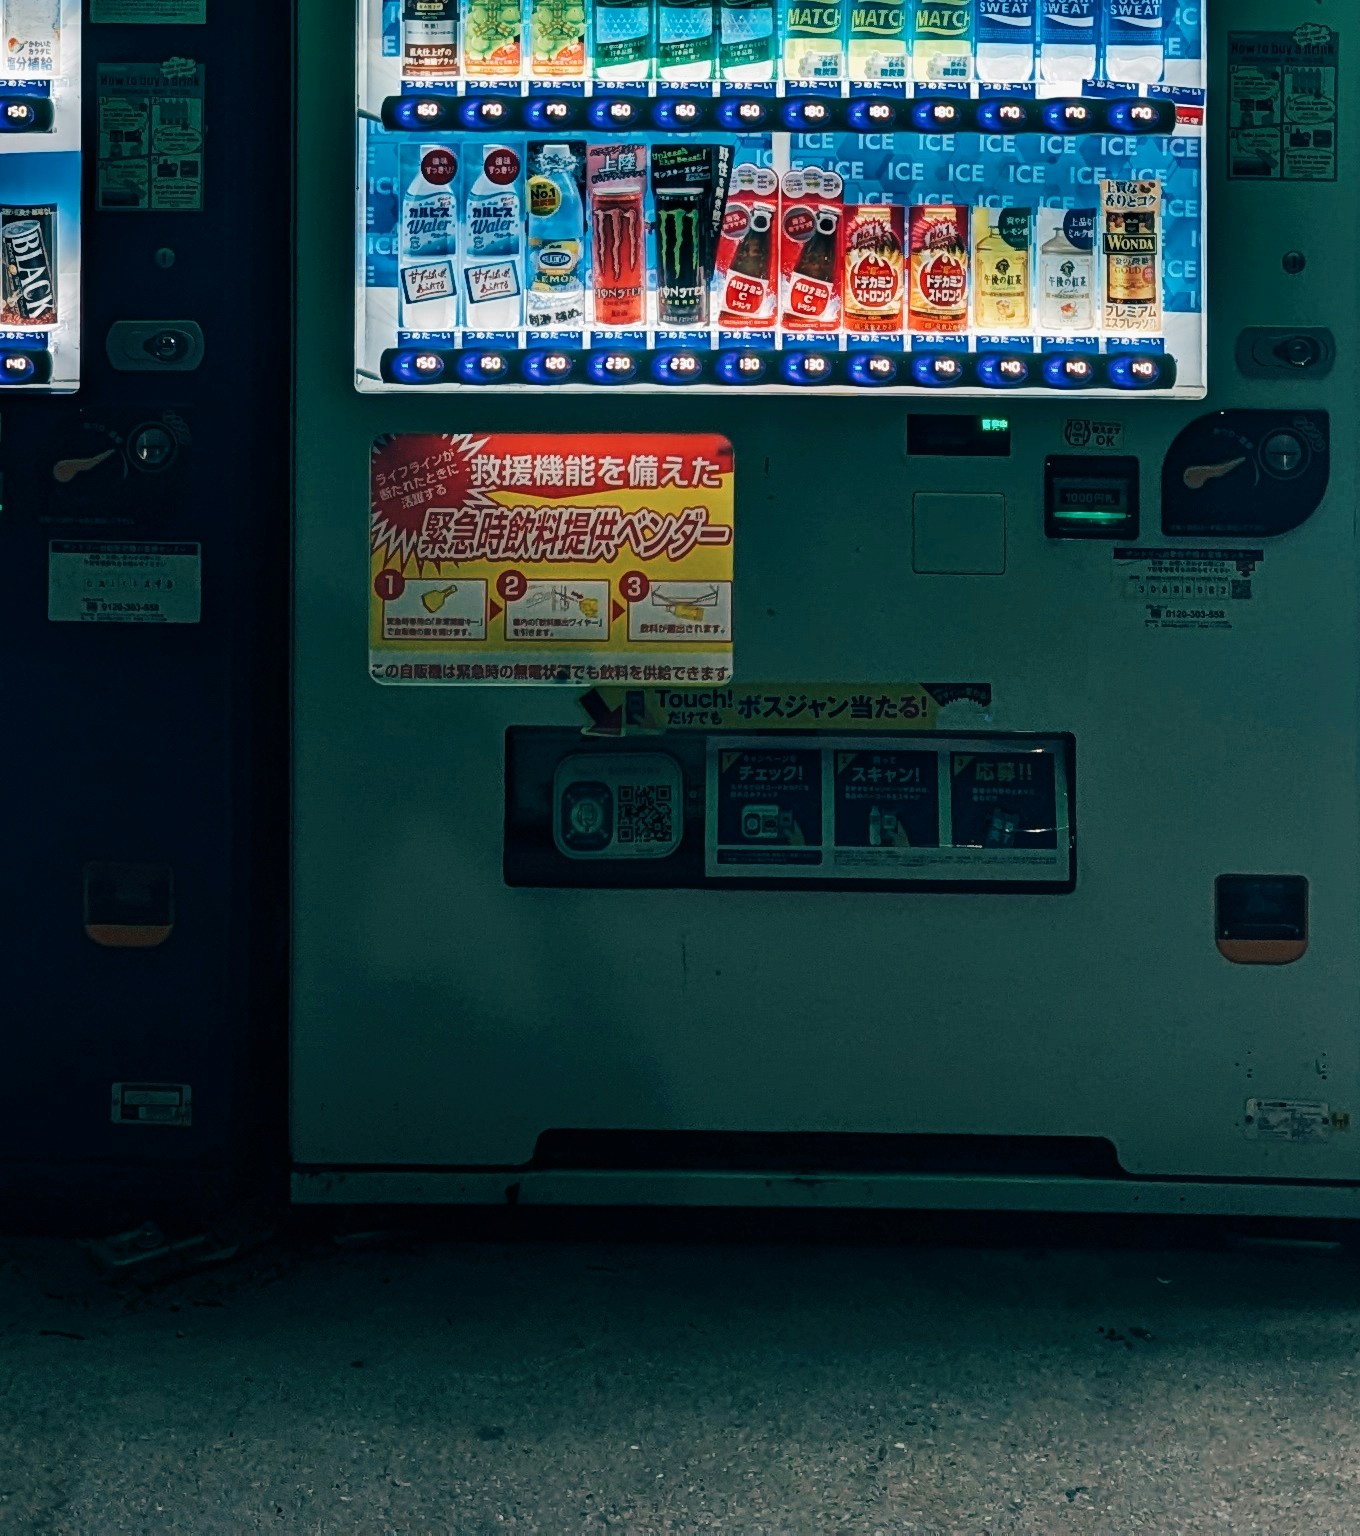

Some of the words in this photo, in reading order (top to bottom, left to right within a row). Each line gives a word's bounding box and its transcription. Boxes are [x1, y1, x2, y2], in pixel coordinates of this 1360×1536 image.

[979, 3, 1027, 14] SWEAT
[1043, 4, 1090, 15] SWEAT
[1110, 4, 1160, 16] SWEAT
[799, 133, 834, 149] ICE
[858, 133, 894, 152] ICE
[919, 133, 954, 152] ICE
[979, 134, 1015, 153] ICE
[597, 154, 636, 173] 上陸
[1106, 181, 1138, 195] 上質な
[1104, 194, 1156, 207] 香りとコク
[409, 207, 452, 218] カルピス
[472, 207, 515, 218] カルピス
[407, 218, 452, 235] Water
[470, 218, 515, 235] Water
[1106, 237, 1153, 252] WONDA
[12, 231, 54, 319] BLACK
[534, 275, 576, 283] LEMON
[854, 274, 893, 289] ドデカミン
[926, 274, 964, 289] ドデカミン
[984, 275, 1023, 287] 午後の紅茶
[1048, 276, 1087, 288] 午後の紅茶
[729, 280, 763, 296] オロナミン
[795, 281, 828, 299] オロナミン
[855, 289, 891, 303] ストロング
[928, 289, 962, 303] ストロング
[1105, 305, 1156, 318] プレミアム
[1095, 435, 1115, 446] OK
[375, 449, 455, 485] ライフラインが
[471, 454, 721, 487] 救援機能を備えた
[379, 464, 459, 501] 断たれたときに
[401, 485, 447, 509] 活躍する
[419, 508, 731, 561] 緊急時飲料提供ベンダー
[384, 576, 395, 594] 1
[504, 577, 519, 596] 2
[627, 577, 641, 595] 3
[656, 690, 732, 708] Touch!
[736, 694, 928, 721] ボスジャン当たる!
[668, 711, 722, 725] だけでも
[739, 766, 802, 782] チェック!
[852, 767, 920, 783] スキャン!
